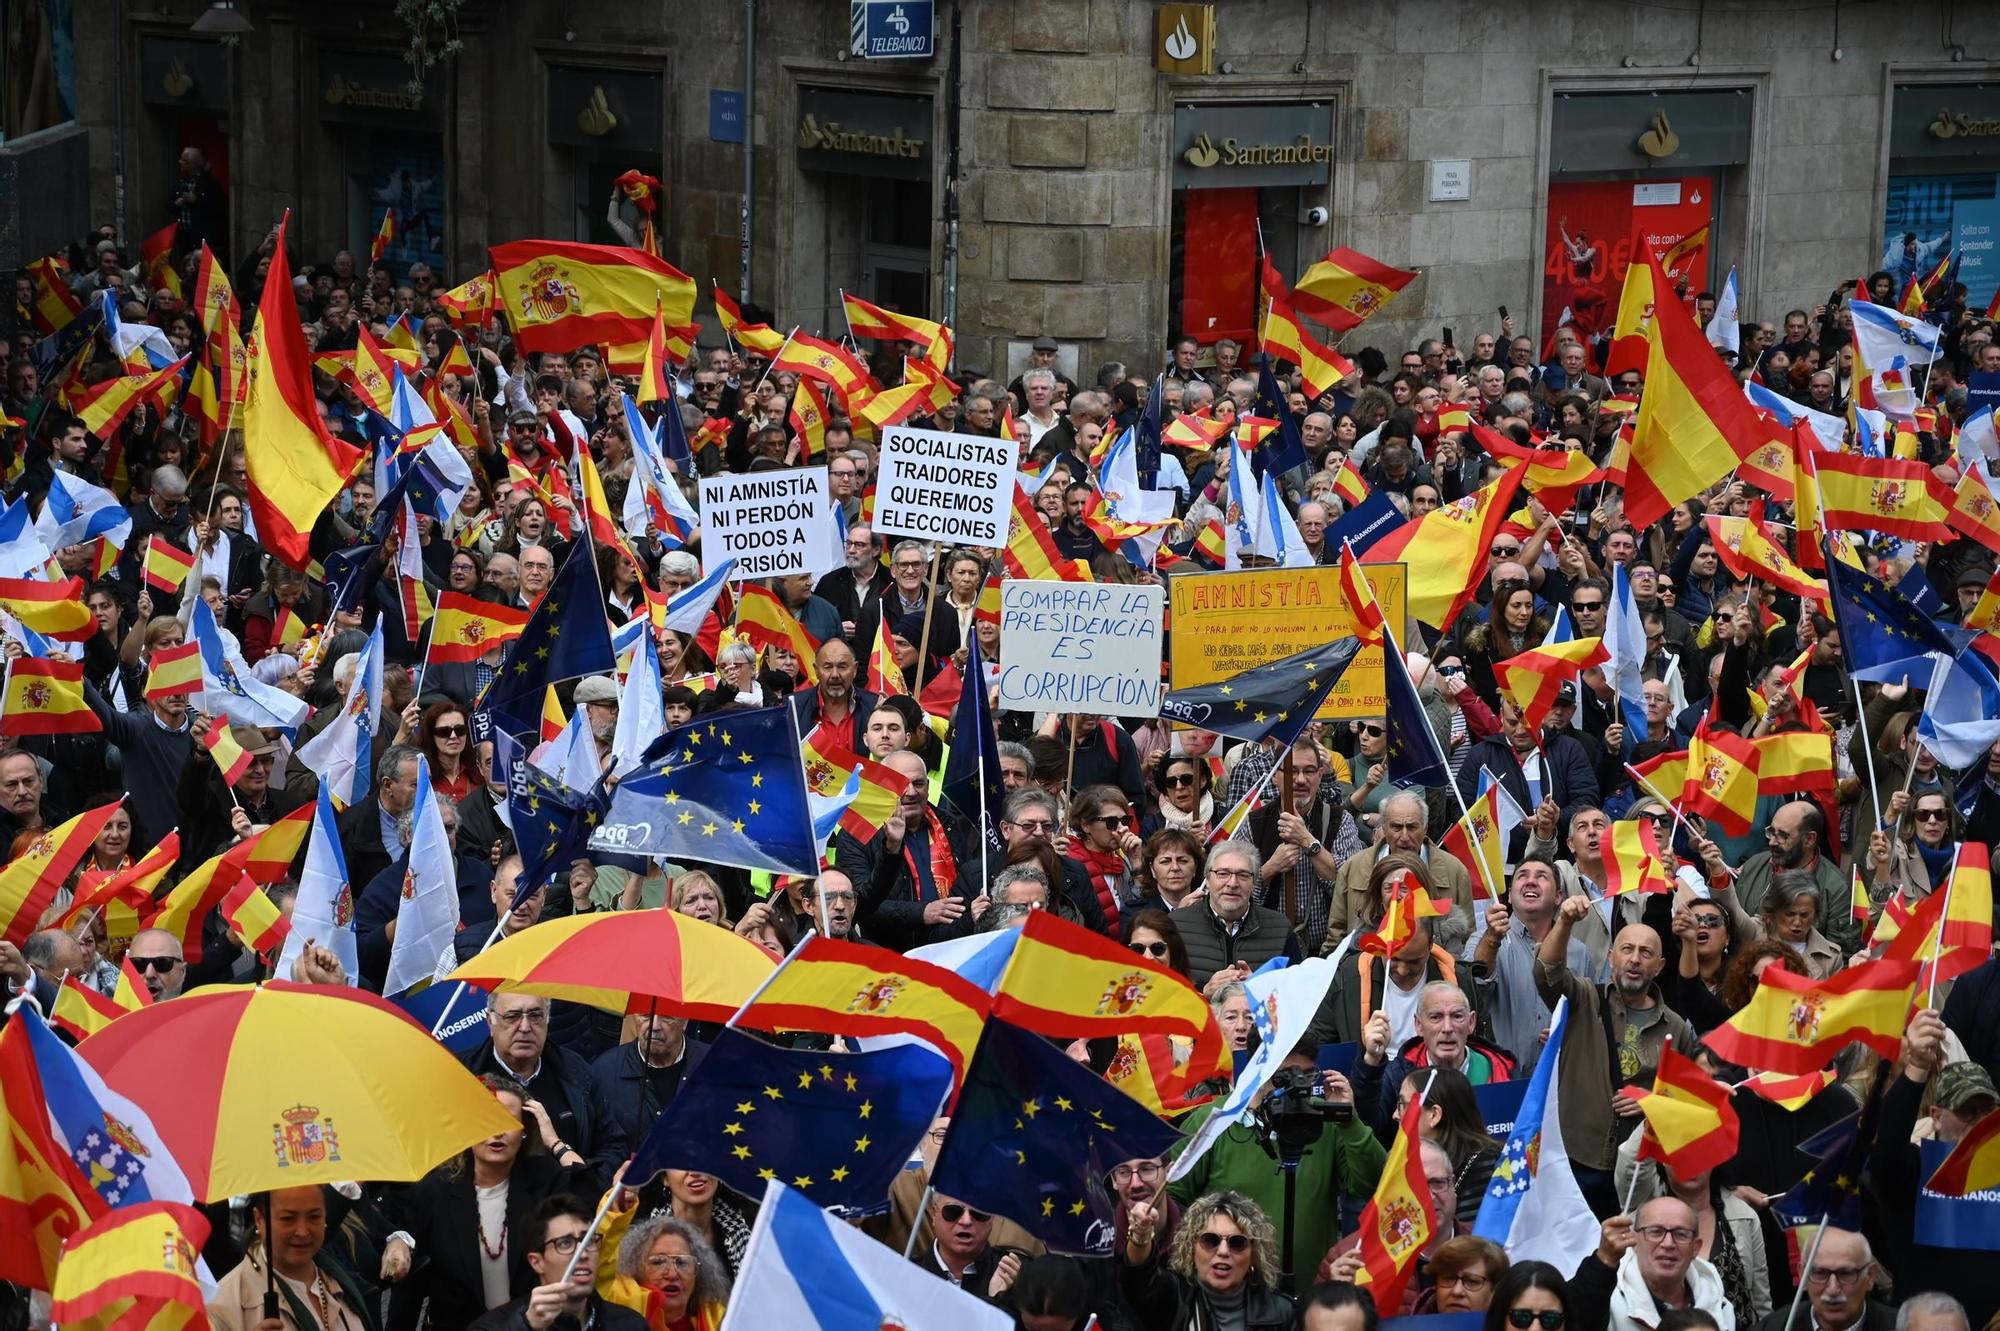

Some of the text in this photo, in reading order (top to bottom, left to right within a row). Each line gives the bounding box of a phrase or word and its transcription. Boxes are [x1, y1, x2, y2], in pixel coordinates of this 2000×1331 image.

[872, 36, 926, 53] TELEBANCO
[821, 122, 925, 158] Santander
[1221, 134, 1334, 166] Santander
[1661, 234, 1676, 245] con
[889, 435, 1008, 466] SOCIALISTAS
[706, 474, 818, 504] NI AMNISTÍA
[894, 460, 998, 490] TRAIDORES
[712, 499, 814, 528] NI PERDÓN
[891, 485, 994, 514] QUEREMOS
[722, 527, 806, 551] TODOS A
[881, 509, 996, 540] ELECCIONES
[1004, 585, 1151, 616] COMPRAR LA
[1205, 625, 1227, 634] PARA
[1249, 625, 1259, 634] NO
[1274, 625, 1306, 634] VUELVAN
[1313, 625, 1319, 633] A
[1051, 636, 1095, 660] ES
[1351, 657, 1385, 667] LECTORA
[435, 1007, 488, 1041] NOSERIN
